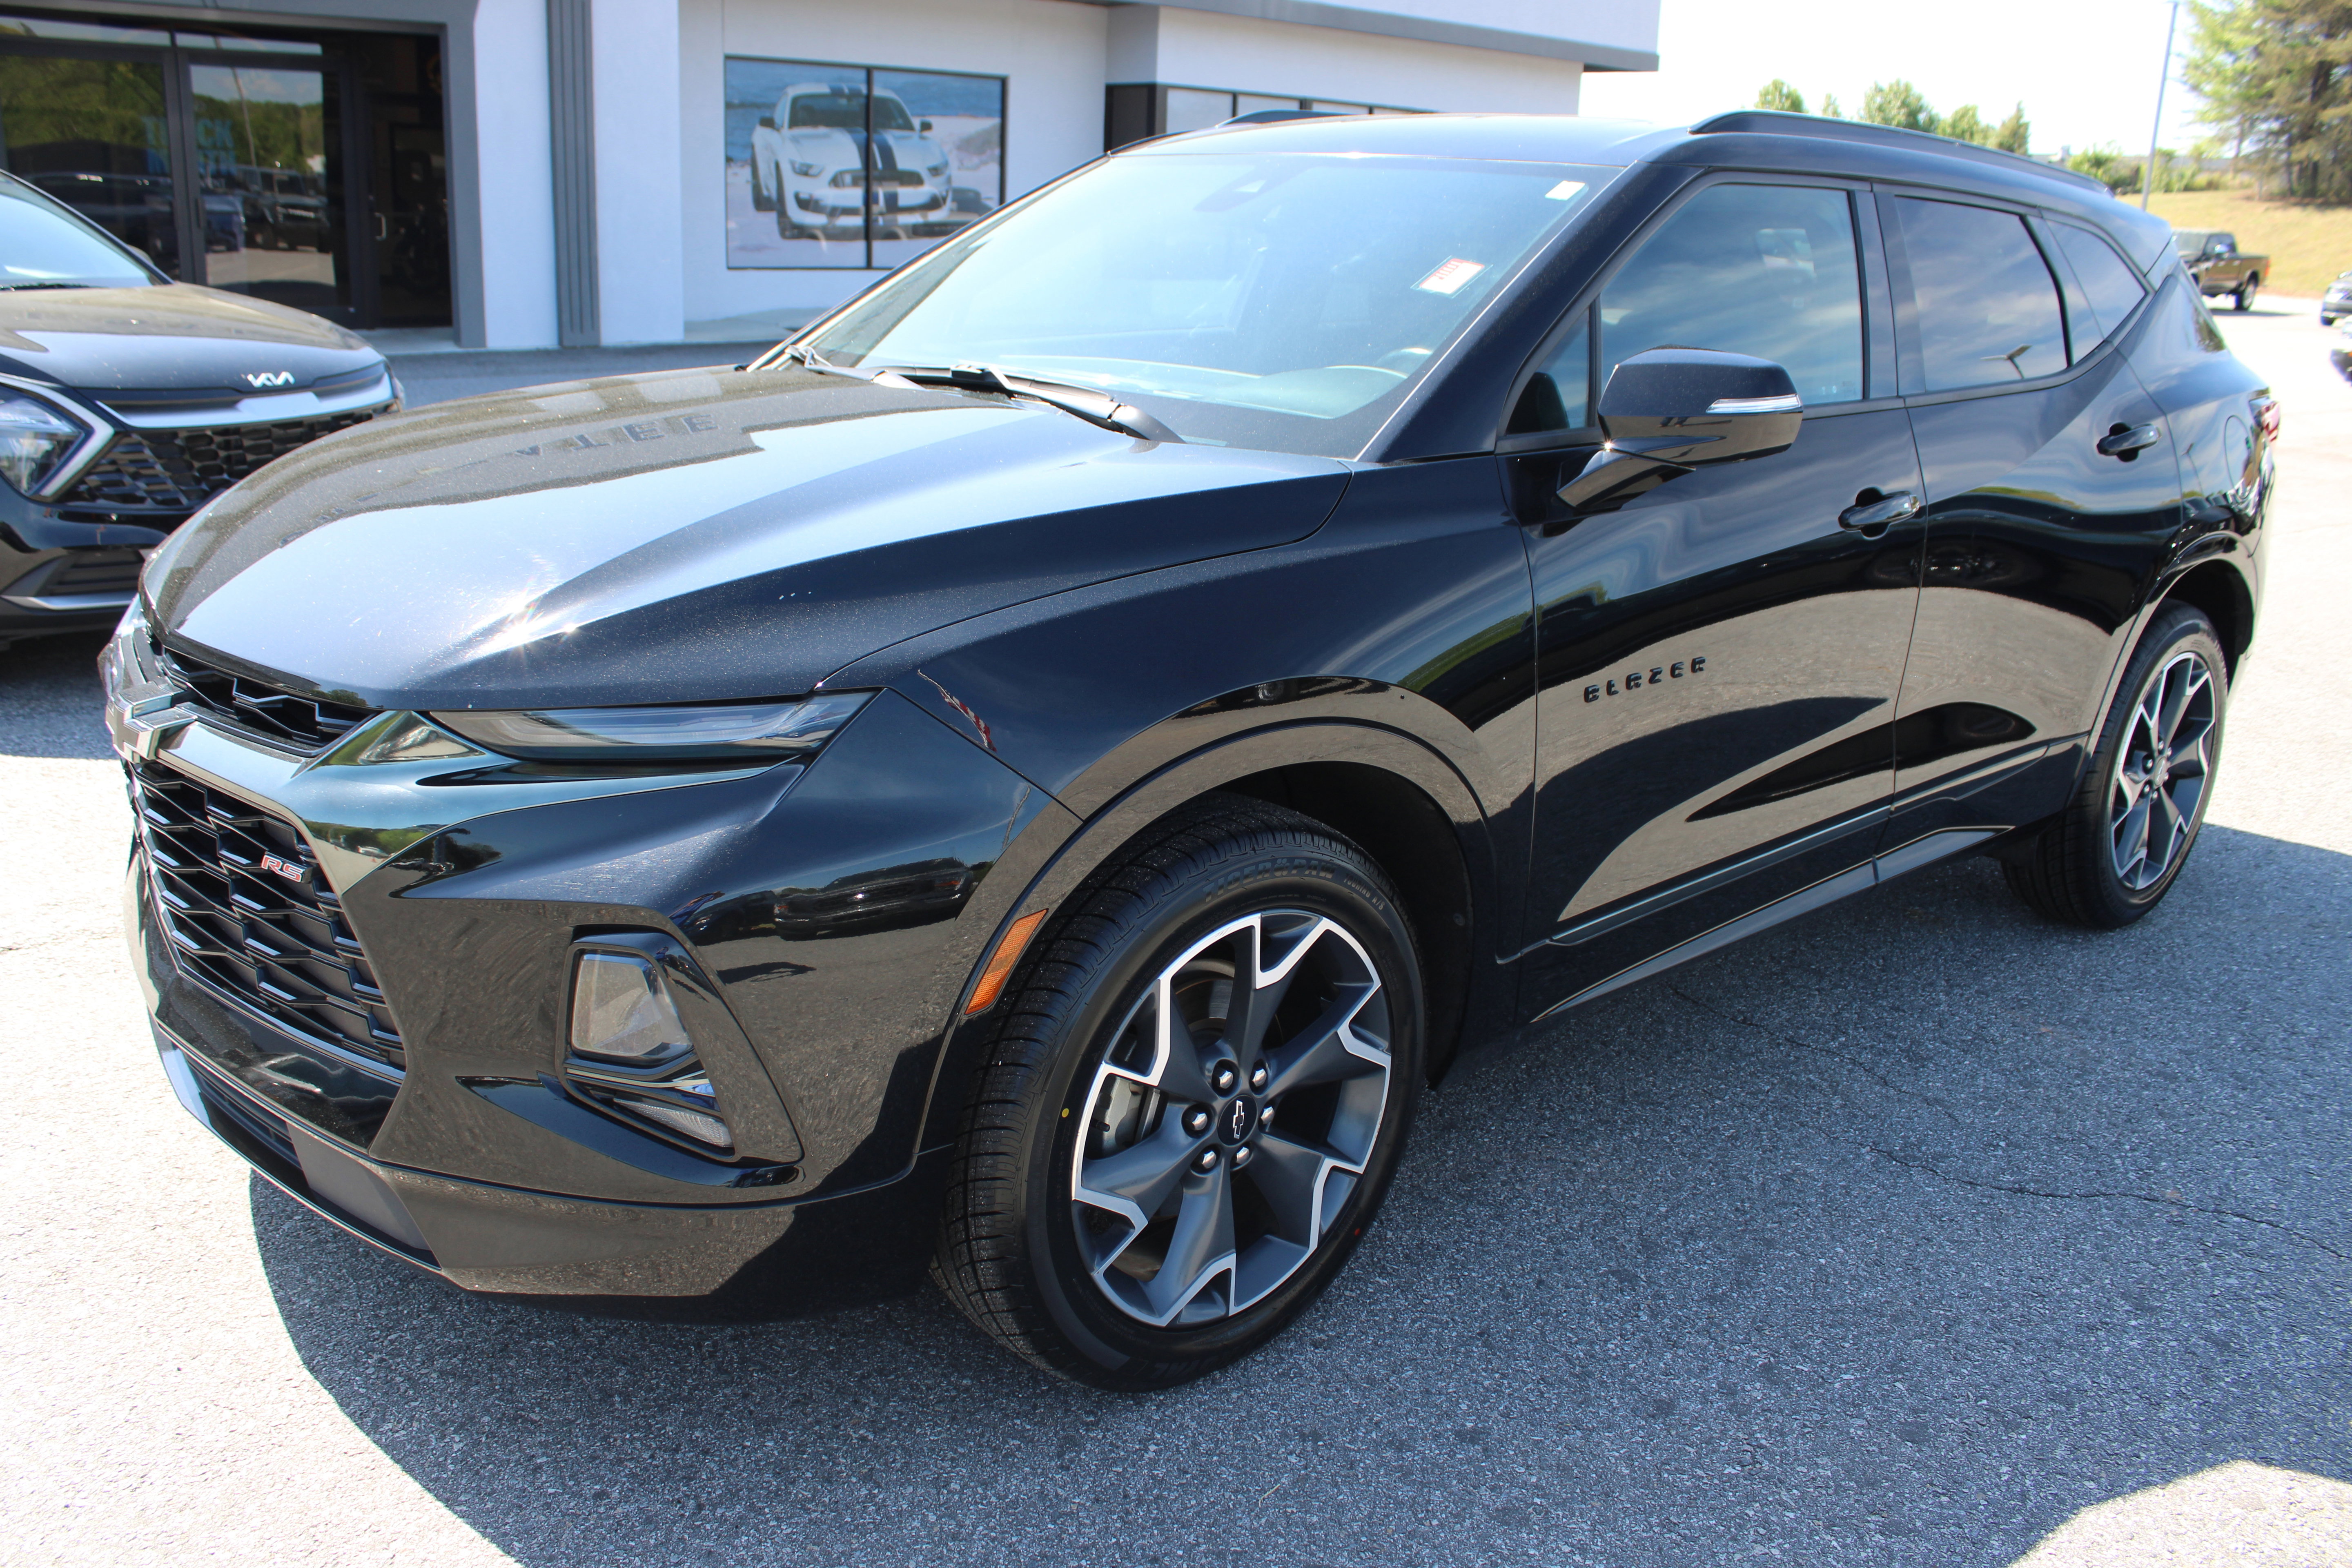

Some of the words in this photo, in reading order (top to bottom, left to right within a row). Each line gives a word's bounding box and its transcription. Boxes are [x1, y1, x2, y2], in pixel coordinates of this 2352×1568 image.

[141, 116, 234, 148] TCK
[247, 371, 295, 388] KIA
[1584, 656, 1706, 703] BLAZER
[261, 855, 305, 882] RS
[1202, 862, 1272, 902] TIGER
[1291, 858, 1337, 879] PAW
[1343, 872, 1370, 898] TOURING
[1372, 893, 1386, 911] A/S
